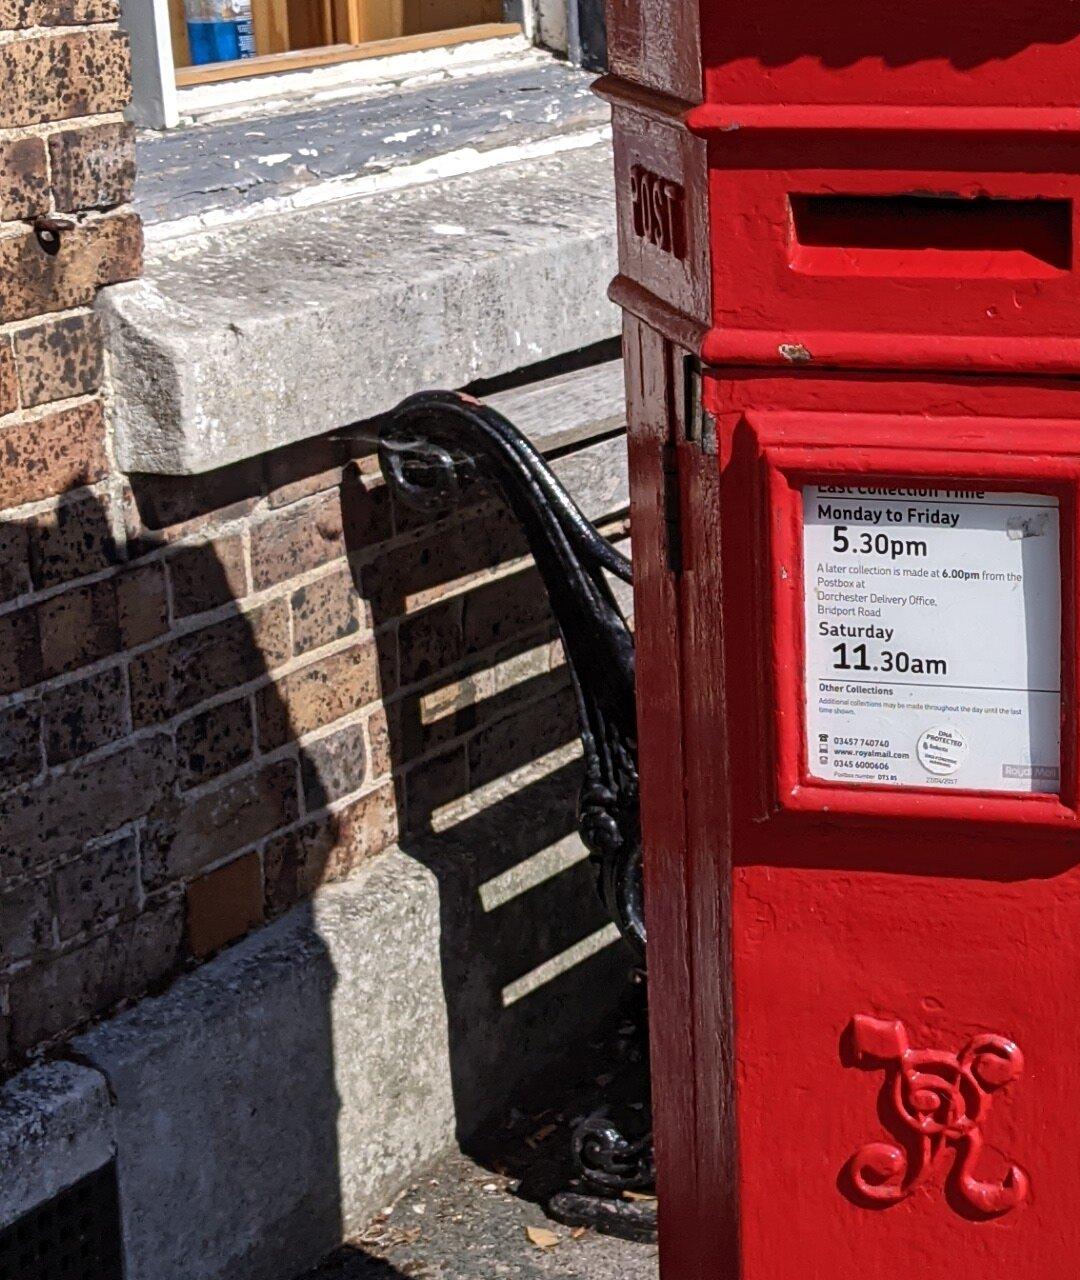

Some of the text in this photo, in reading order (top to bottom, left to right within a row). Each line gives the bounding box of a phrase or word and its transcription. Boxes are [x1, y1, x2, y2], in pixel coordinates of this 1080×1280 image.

[630, 163, 686, 262] POST
[818, 504, 960, 527] Monday to Friday
[833, 525, 927, 560] 5.30pm
[817, 563, 1022, 582] A later collection is made at 6.00pm from the
[817, 577, 866, 589] Postbox at
[817, 591, 868, 603] Dorchester
[870, 593, 907, 607] Delivery
[817, 605, 881, 617] Bridport Road
[819, 621, 894, 642] Saturday
[832, 642, 947, 675] 11.30am
[819, 683, 894, 696] Other Collections
[850, 699, 882, 708] collections
[883, 701, 896, 709] may
[897, 701, 905, 709] be
[924, 703, 959, 712] throughout
[960, 705, 971, 713] the
[972, 706, 983, 714] day
[984, 706, 998, 714] until
[999, 706, 1009, 714] the
[1010, 707, 1022, 715] last
[834, 737, 889, 747] 03457 740740
[926, 734, 962, 747] PROTECTED
[834, 749, 910, 759] www.royalmail.com
[834, 760, 853, 769] 0345
[1034, 767, 1056, 777] Mail
